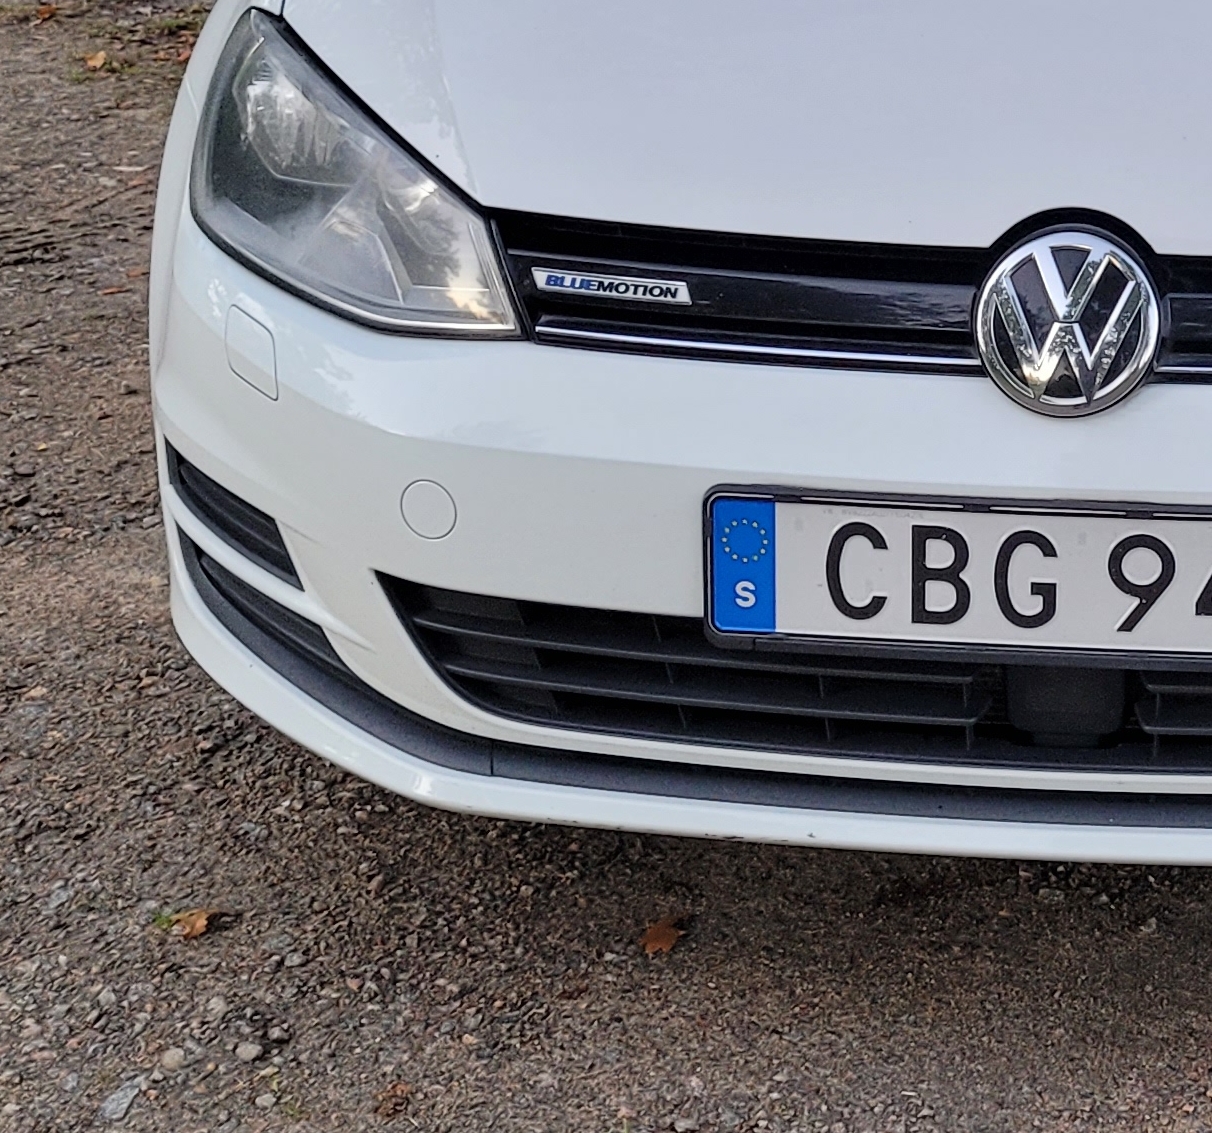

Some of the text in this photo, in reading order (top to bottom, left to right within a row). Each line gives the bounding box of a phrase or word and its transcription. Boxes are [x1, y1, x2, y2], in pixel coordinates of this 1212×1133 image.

[545, 274, 679, 300] BLUEMOTION
[986, 236, 1148, 412] VW
[733, 579, 757, 609] S
[824, 521, 1059, 629] CBG
